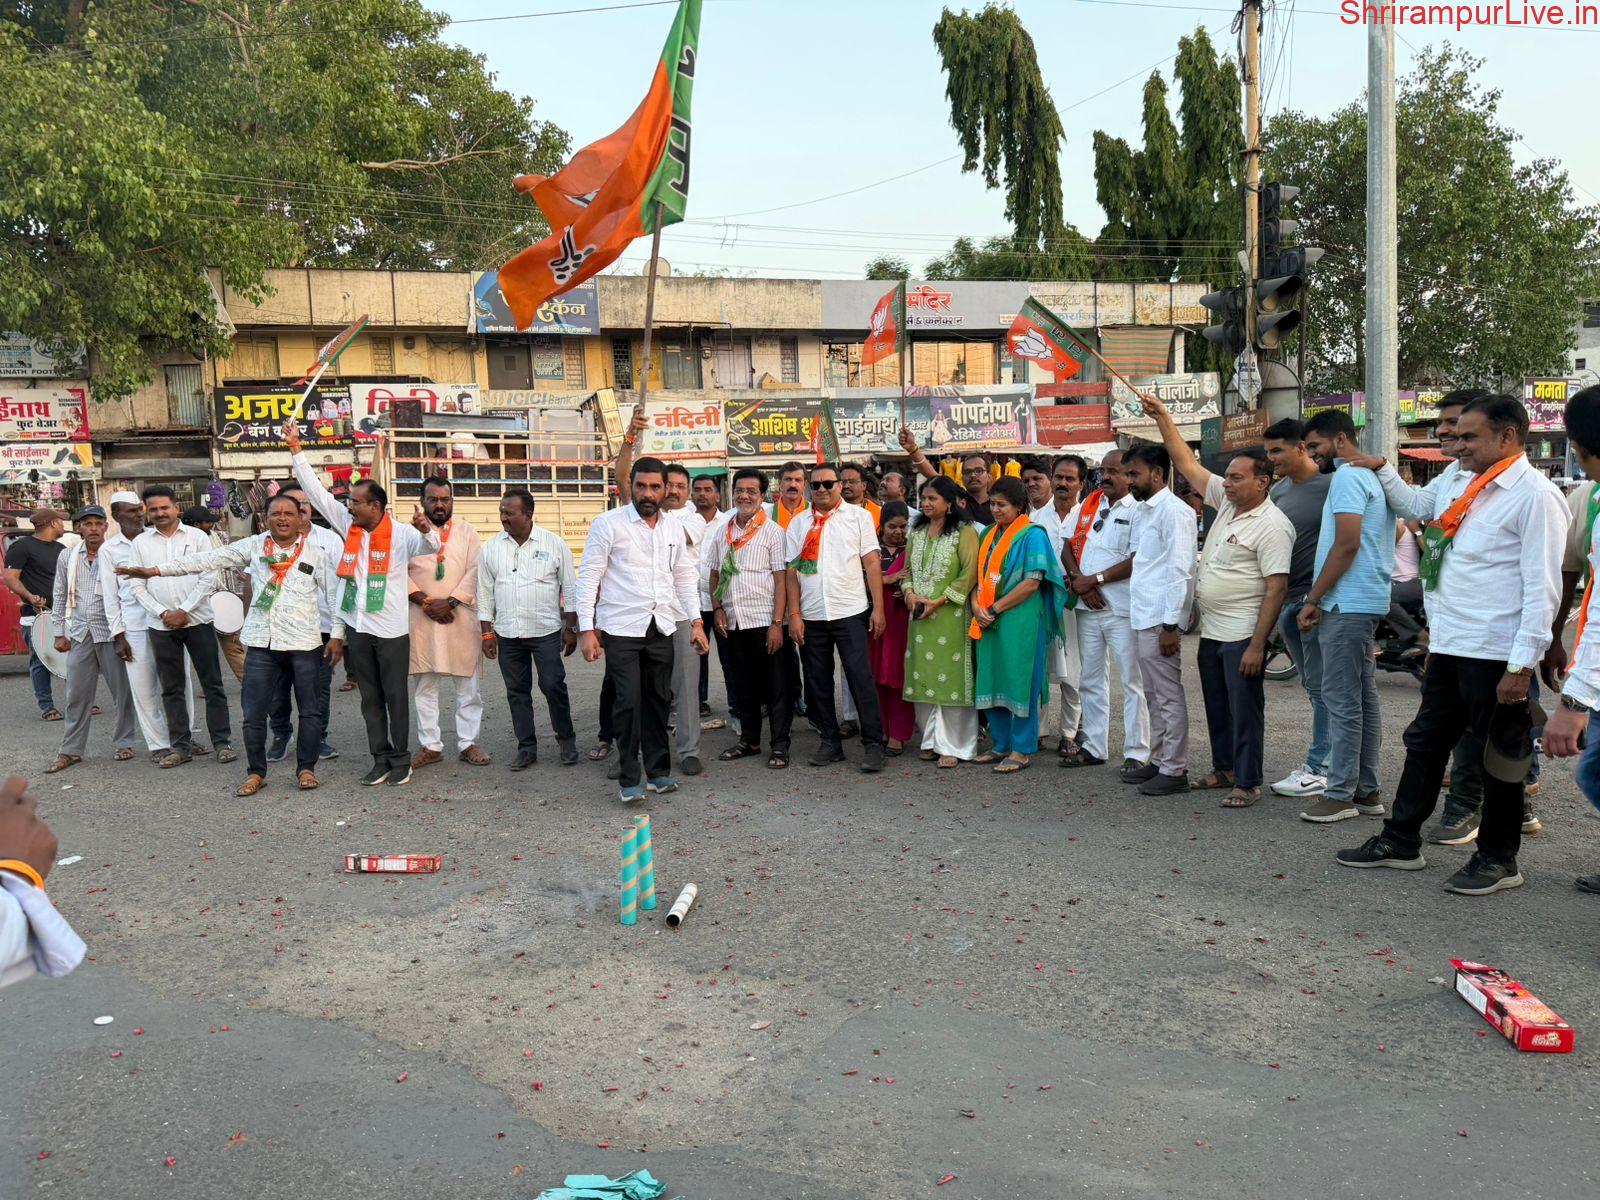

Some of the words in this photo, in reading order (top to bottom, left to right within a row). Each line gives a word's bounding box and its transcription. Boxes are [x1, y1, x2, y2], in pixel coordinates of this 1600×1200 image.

[1158, 378, 1200, 400] बालाजी
[1534, 381, 1567, 399] ममता
[0, 397, 50, 421] ईनाथ
[224, 394, 305, 420] अजय
[653, 405, 721, 429] नंदिनी
[751, 413, 798, 436] आशिष
[834, 413, 896, 437] साईनाथ
